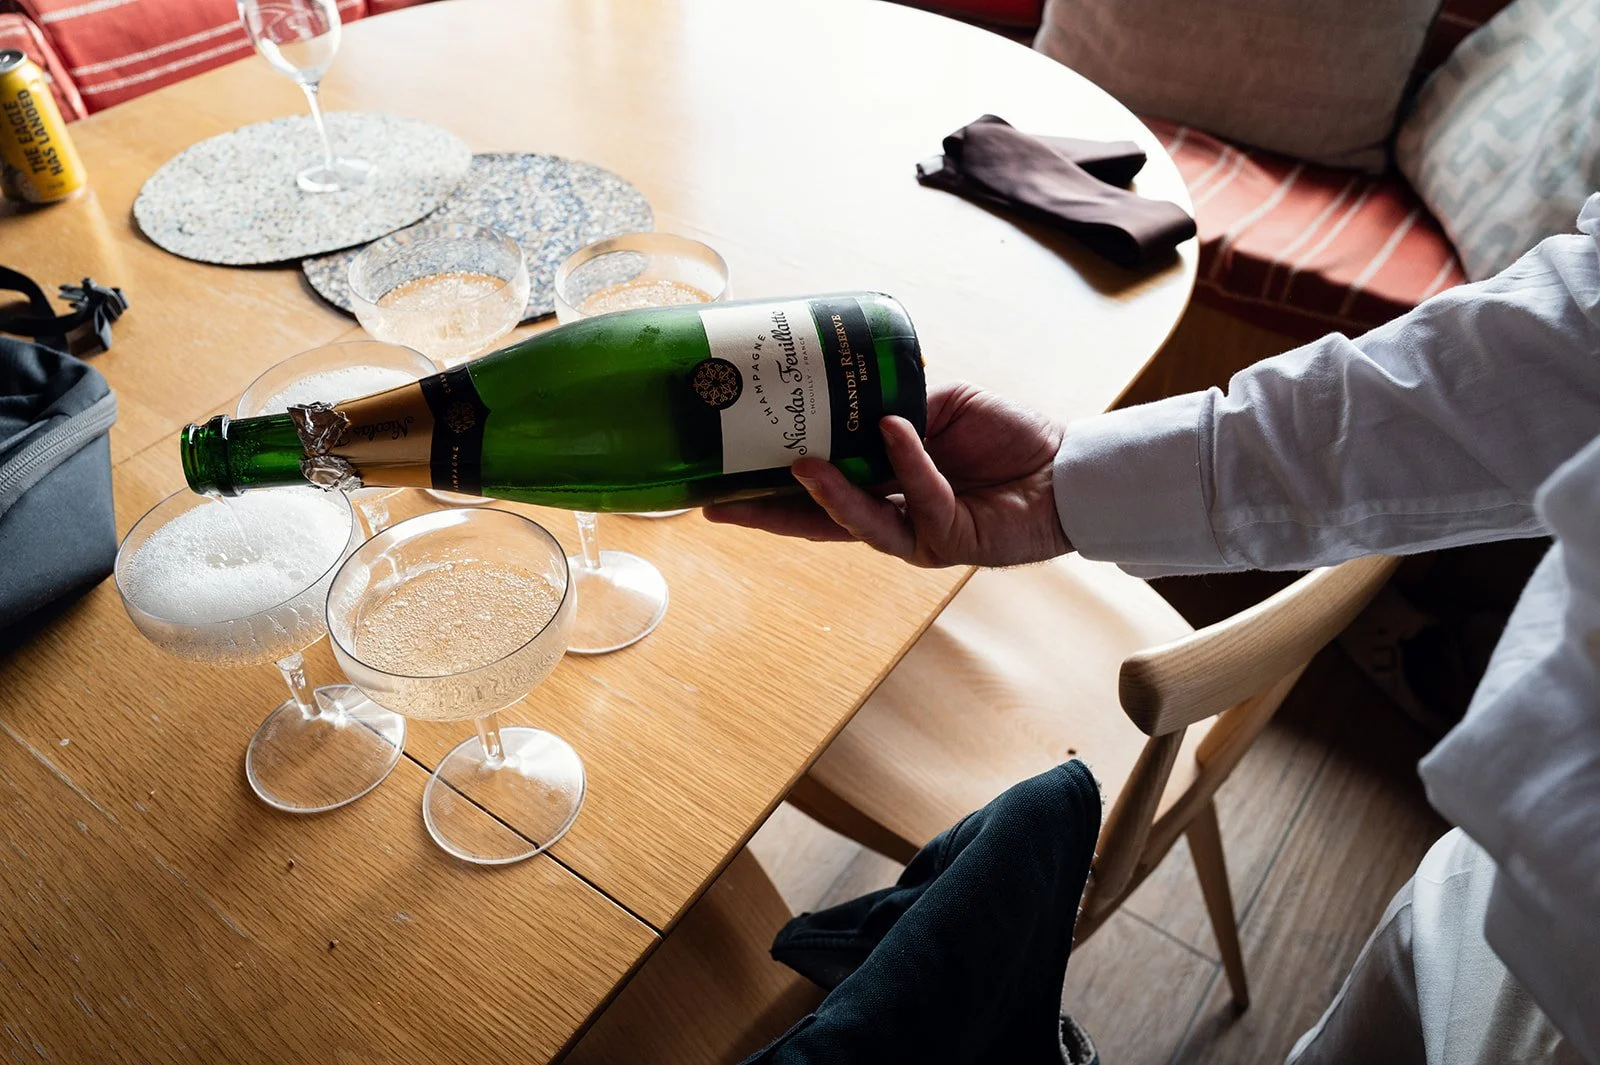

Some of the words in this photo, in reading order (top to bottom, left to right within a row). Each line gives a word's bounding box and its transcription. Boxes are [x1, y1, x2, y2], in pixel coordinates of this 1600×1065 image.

[4, 101, 34, 145] EAGLE
[18, 89, 49, 145] LANDED
[23, 147, 47, 174] THE
[43, 146, 63, 176] HAS
[770, 310, 803, 384] Feuillatte
[799, 336, 809, 366] FRANCE
[831, 314, 853, 367] RÉSERVE
[752, 334, 779, 425] CHAMPAGNE
[856, 353, 868, 381] BRUT
[807, 375, 816, 415] CHOUILLY
[846, 371, 859, 432] GRANDE
[353, 416, 414, 441] Nicolas
[783, 387, 808, 456] Nicolas
[451, 446, 459, 492] AMPAGNE
